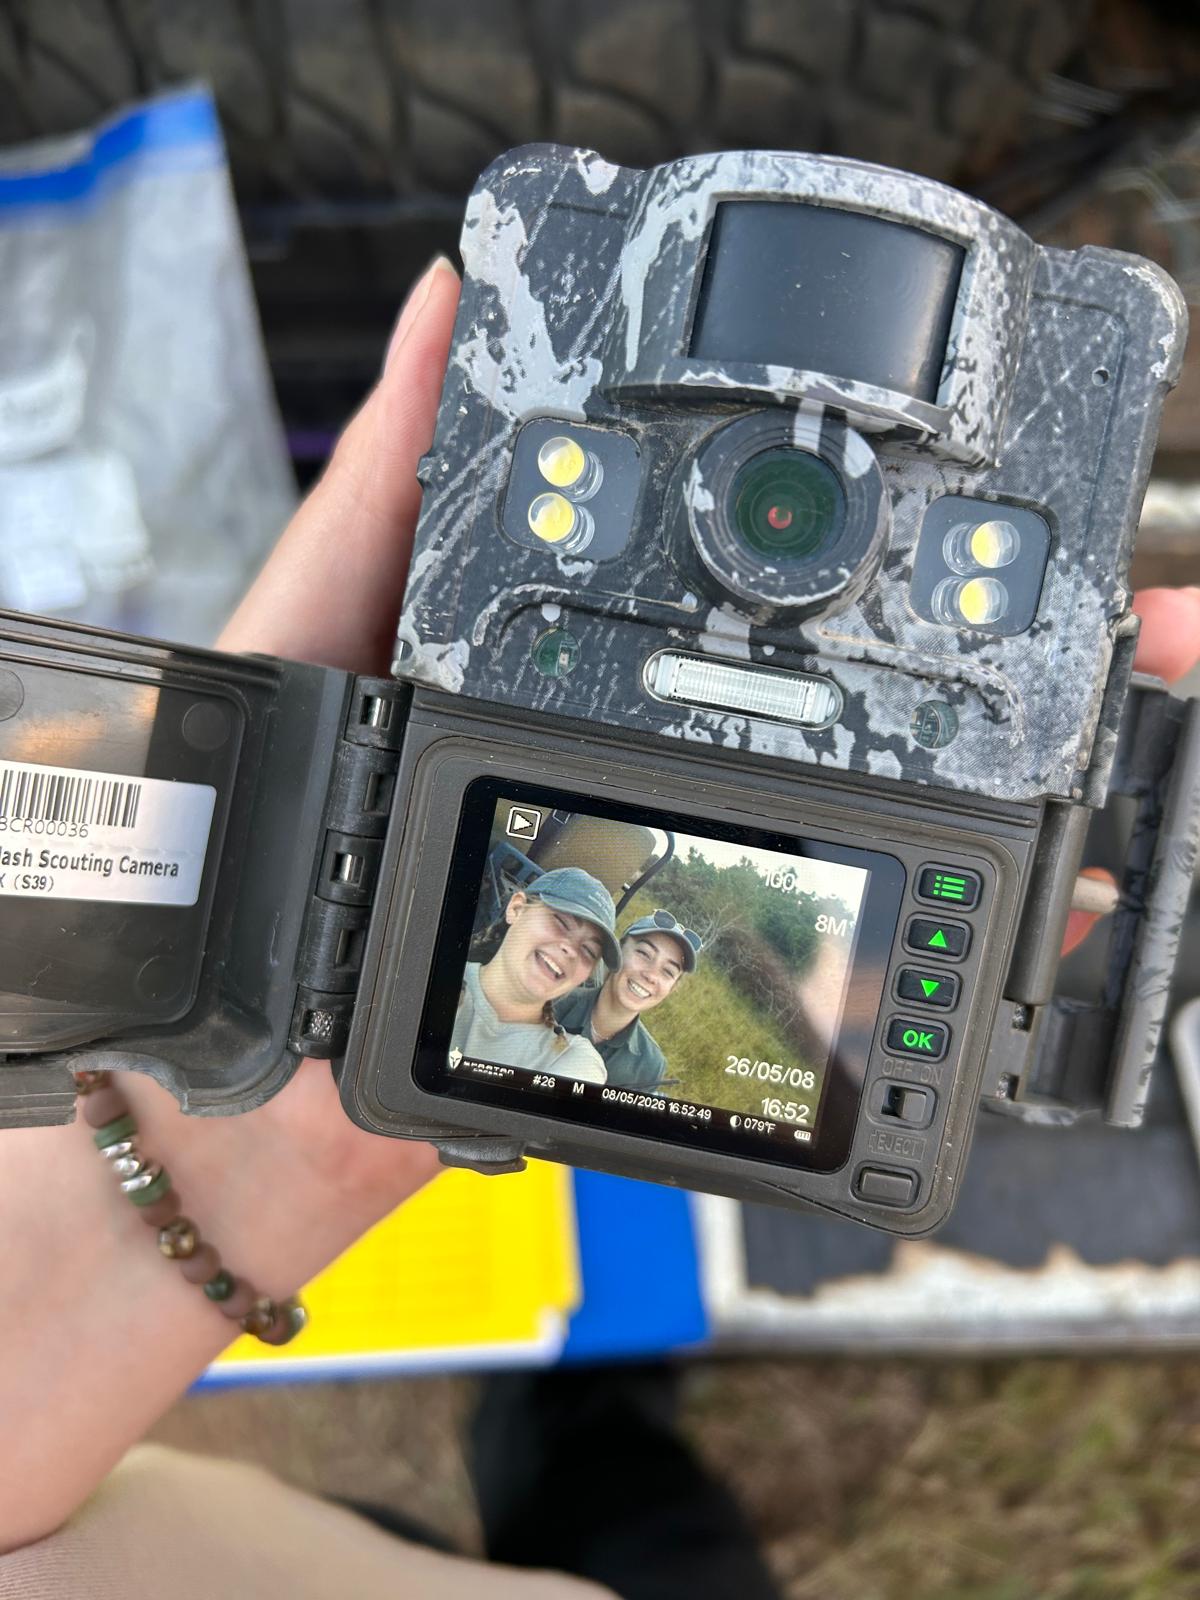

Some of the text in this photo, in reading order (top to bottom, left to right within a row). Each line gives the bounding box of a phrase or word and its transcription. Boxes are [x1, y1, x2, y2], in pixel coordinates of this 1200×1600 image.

[38, 849, 114, 877] Scouting
[119, 855, 179, 877] Camera
[14, 873, 55, 891] (S39)
[815, 914, 848, 937] 8M
[902, 1029, 935, 1050] OK
[725, 1055, 815, 1089] 26/05/08
[881, 1059, 944, 1085] OFF ON
[532, 1073, 556, 1089] #26
[572, 1081, 585, 1095] M
[602, 1088, 666, 1109] 08/05/2026
[668, 1102, 712, 1120] 16:52:49
[761, 1097, 810, 1124] 16:52
[877, 1133, 920, 1156] EJECT
